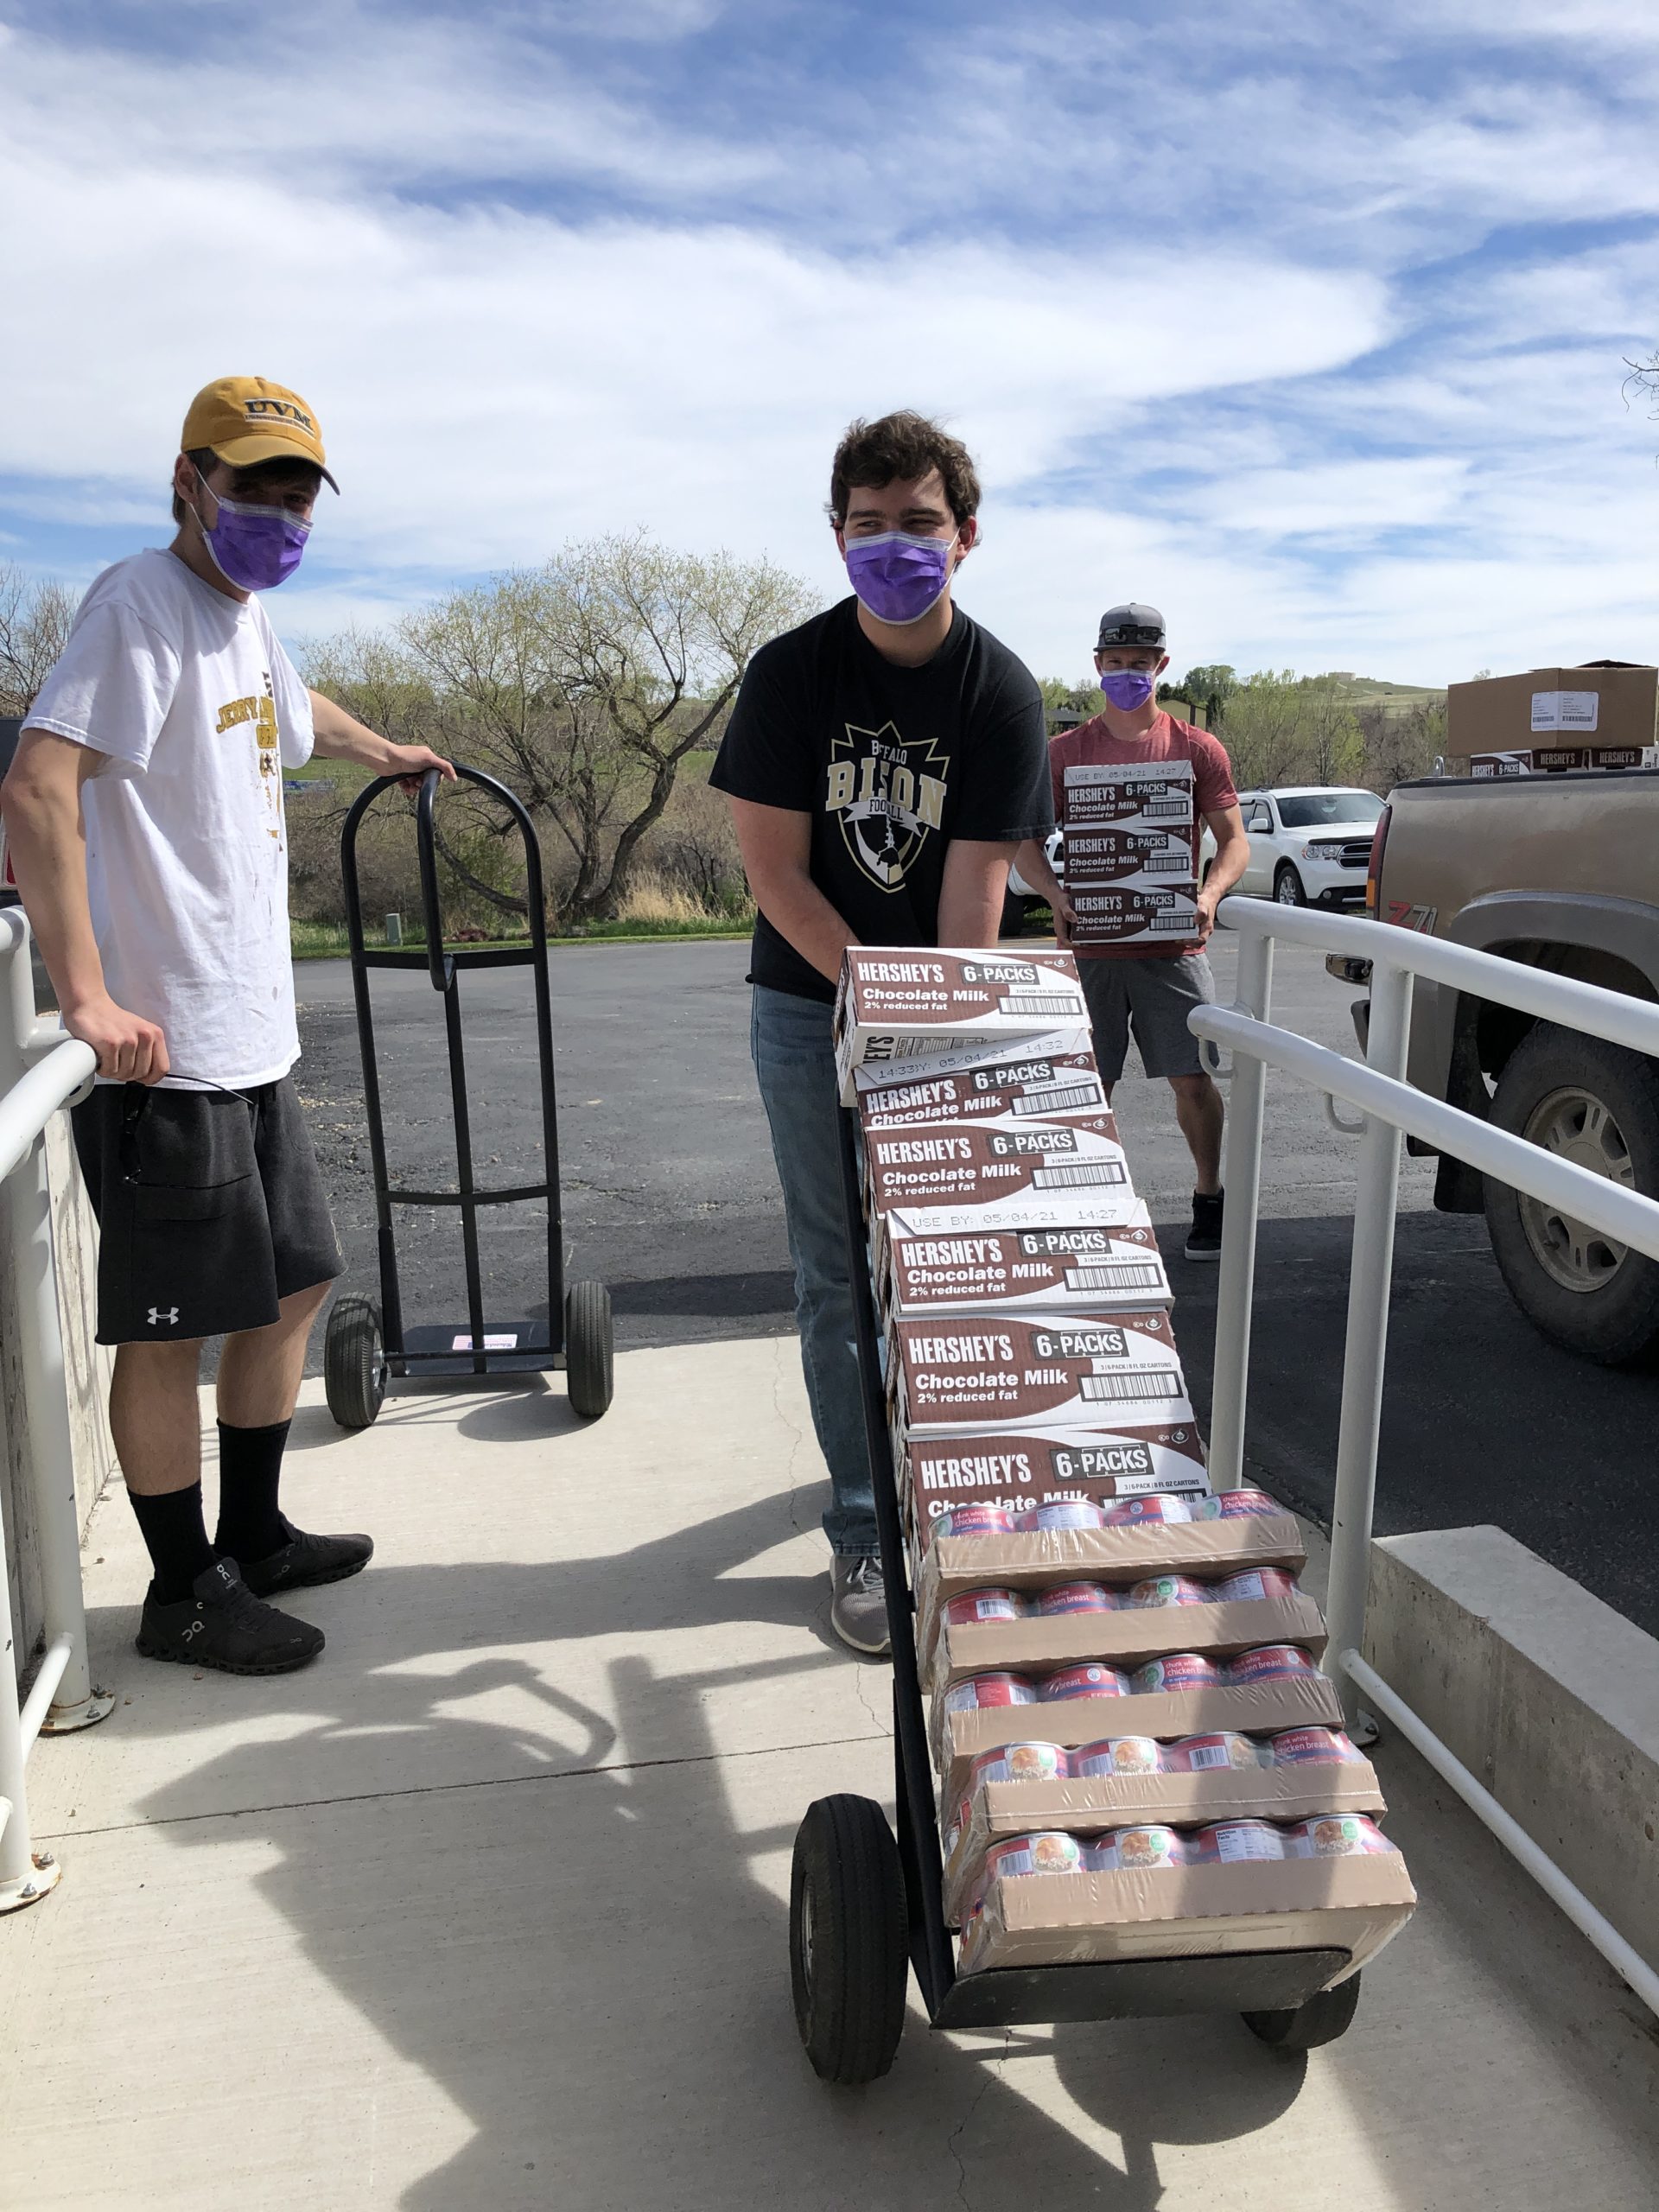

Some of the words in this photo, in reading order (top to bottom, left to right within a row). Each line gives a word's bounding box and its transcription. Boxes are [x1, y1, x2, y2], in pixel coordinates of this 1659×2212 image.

[216, 696, 258, 734] JERRY
[1541, 753, 1575, 765] HERSHEY'S
[1599, 751, 1635, 763] HERSHEY'S
[1068, 786, 1116, 803] HERSHEY'S
[1126, 783, 1166, 796] 6-PACKS
[1069, 804, 1116, 813] Chocolate
[1118, 801, 1139, 810] Milk
[1068, 837, 1116, 853] HERSHEY'S
[1127, 836, 1166, 849] 6-PACKS
[1069, 857, 1116, 867] Chocolate
[1118, 855, 1139, 864] Milk
[1074, 895, 1122, 912] HERSHEY'S
[1133, 895, 1173, 908] 6-PACKS
[1077, 915, 1122, 925] Chocolate
[1125, 913, 1145, 922] Milk
[857, 963, 944, 983] HERSHEY'S
[963, 964, 1036, 982] 6-PACKS
[862, 988, 949, 1001] Chocolate
[953, 990, 989, 1002] Milk
[883, 1001, 932, 1010] reduced
[935, 1002, 948, 1011] fat
[938, 1049, 1007, 1068] 05/04/21
[1025, 1039, 1064, 1053] 14:32
[866, 1080, 957, 1114] HERSHEY'S
[974, 1063, 1051, 1090] 6-PACKS
[871, 1105, 959, 1126] Chocolate
[964, 1096, 1002, 1112] Milk
[877, 1137, 972, 1165] HERSHEY'S
[993, 1132, 1073, 1154] 6-PACKS
[882, 1166, 976, 1185] Chocolate
[982, 1163, 1022, 1179] Milk
[884, 1187, 902, 1197] 2%
[905, 1184, 956, 1195] reduced
[957, 1182, 976, 1192] fat
[912, 1216, 940, 1228] USE
[950, 1214, 974, 1226] BY:
[983, 1210, 1058, 1224] 05/04/21
[1077, 1209, 1117, 1220] 14:27
[901, 1238, 1002, 1267] HERSHEY'S
[1022, 1232, 1107, 1255] 6-PACKS
[907, 1266, 1007, 1285] Chocolate
[1012, 1263, 1054, 1279] Milk
[909, 1287, 928, 1296] 2%
[931, 1284, 984, 1295] reduced
[987, 1282, 1006, 1293] fat
[909, 1335, 1014, 1364] HERSHEY'S
[1036, 1333, 1123, 1357] 6-PACKS
[915, 1371, 1019, 1389] Chocolate
[1025, 1369, 1069, 1386] Milk
[918, 1394, 937, 1403] 2%
[940, 1391, 995, 1402] reduced
[999, 1389, 1018, 1400] fat
[922, 1452, 1032, 1490] HERSHEY'S
[1055, 1451, 1149, 1478] 6-PACKS
[928, 1496, 1037, 1518] Chlate
[955, 1517, 982, 1527] chicken
[1067, 1594, 1090, 1604] breast
[1167, 1667, 1196, 1676] chicken
[1258, 1658, 1281, 1669] breast
[1278, 1743, 1305, 1756] chicken
[1306, 1741, 1329, 1750] breast
